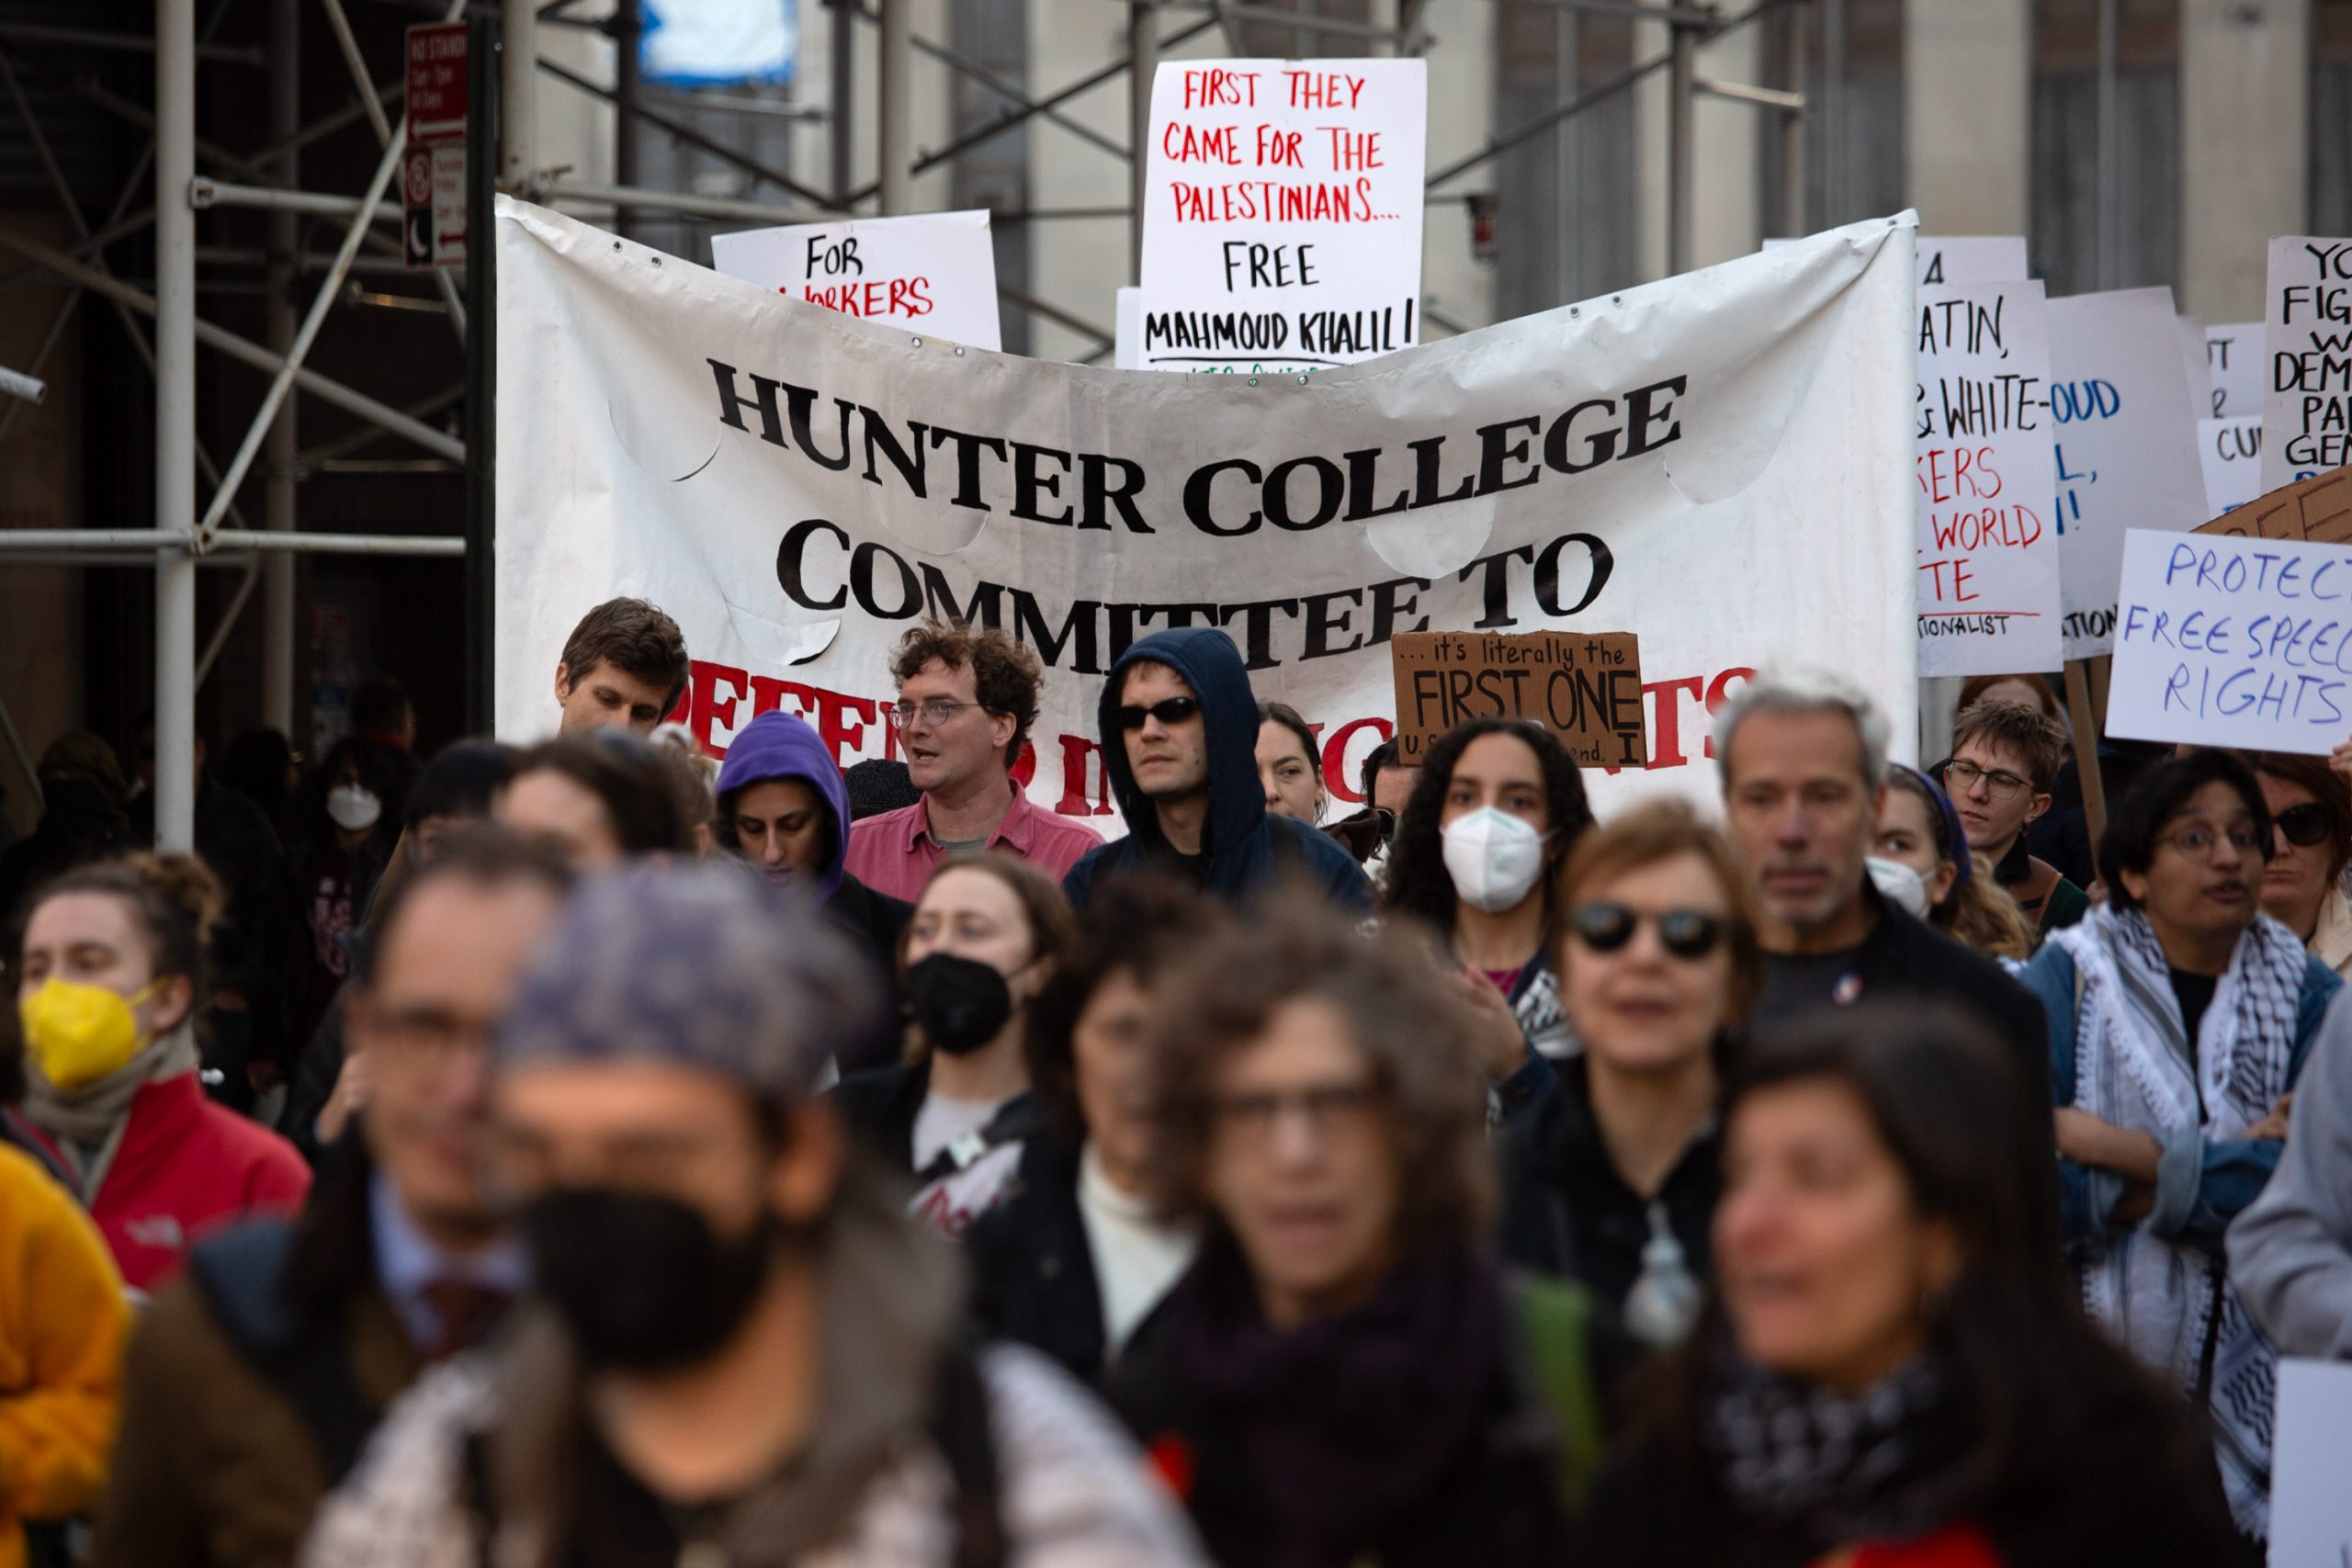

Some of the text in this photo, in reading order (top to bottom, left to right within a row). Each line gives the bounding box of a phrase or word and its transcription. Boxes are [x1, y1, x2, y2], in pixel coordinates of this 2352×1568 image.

[1184, 69, 1365, 110] FIRST THEY
[1163, 122, 1384, 172] CAME FOR THE
[806, 234, 863, 278] FOR
[1223, 242, 1319, 293] FREE
[2283, 287, 2352, 325] FIG
[1146, 311, 1288, 352] MAHMOUD
[2274, 352, 2352, 392] DEM
[2051, 379, 2120, 424] OUD
[2302, 396, 2352, 434] PA
[707, 357, 1687, 537] HUNTER COLLEGE
[1932, 504, 2041, 551] WORLD
[1459, 533, 1614, 629] TO
[1918, 558, 1980, 602] TE
[2061, 604, 2118, 640] TION
[2124, 604, 2232, 654] FREE
[1483, 637, 1574, 671] literally
[1584, 639, 1624, 665] the
[1413, 669, 1641, 733] FIRST ONE
[2164, 662, 2346, 724] RIGHTS
